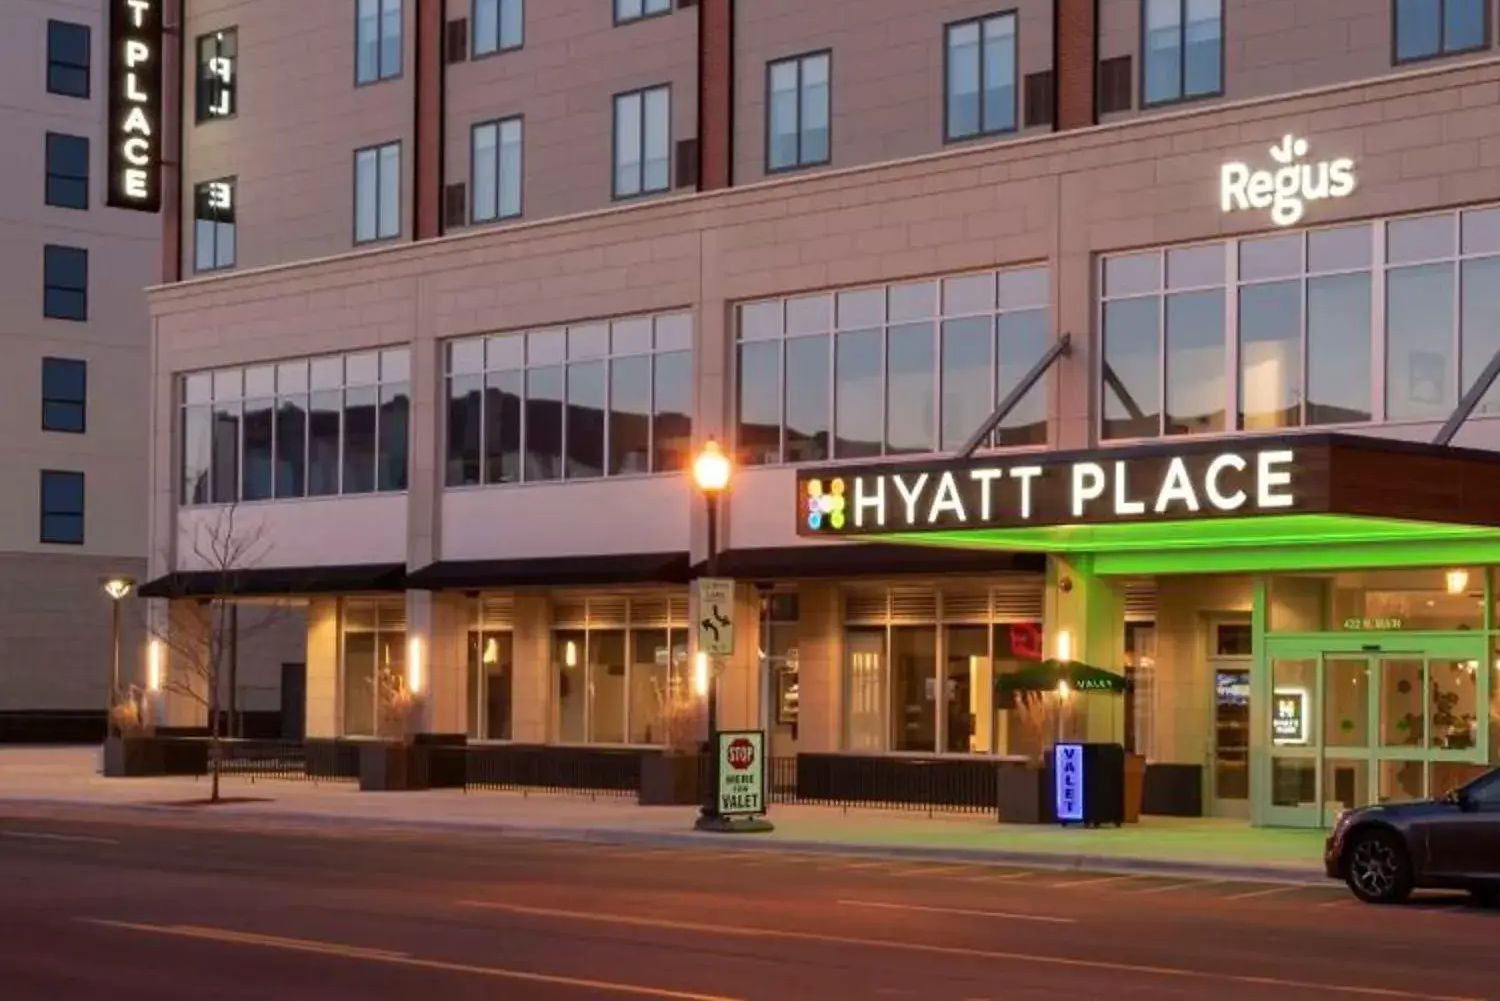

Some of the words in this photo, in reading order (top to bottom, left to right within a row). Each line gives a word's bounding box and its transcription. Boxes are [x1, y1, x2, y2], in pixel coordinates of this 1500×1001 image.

[123, 40, 151, 198] PLACE
[1220, 157, 1356, 226] Regus
[853, 466, 1043, 528] HYATT
[1071, 449, 1295, 517] PLACE
[1076, 678, 1113, 689] VALET
[729, 746, 753, 762] STOP
[1063, 748, 1075, 813] VALET
[722, 793, 758, 808] VALET
